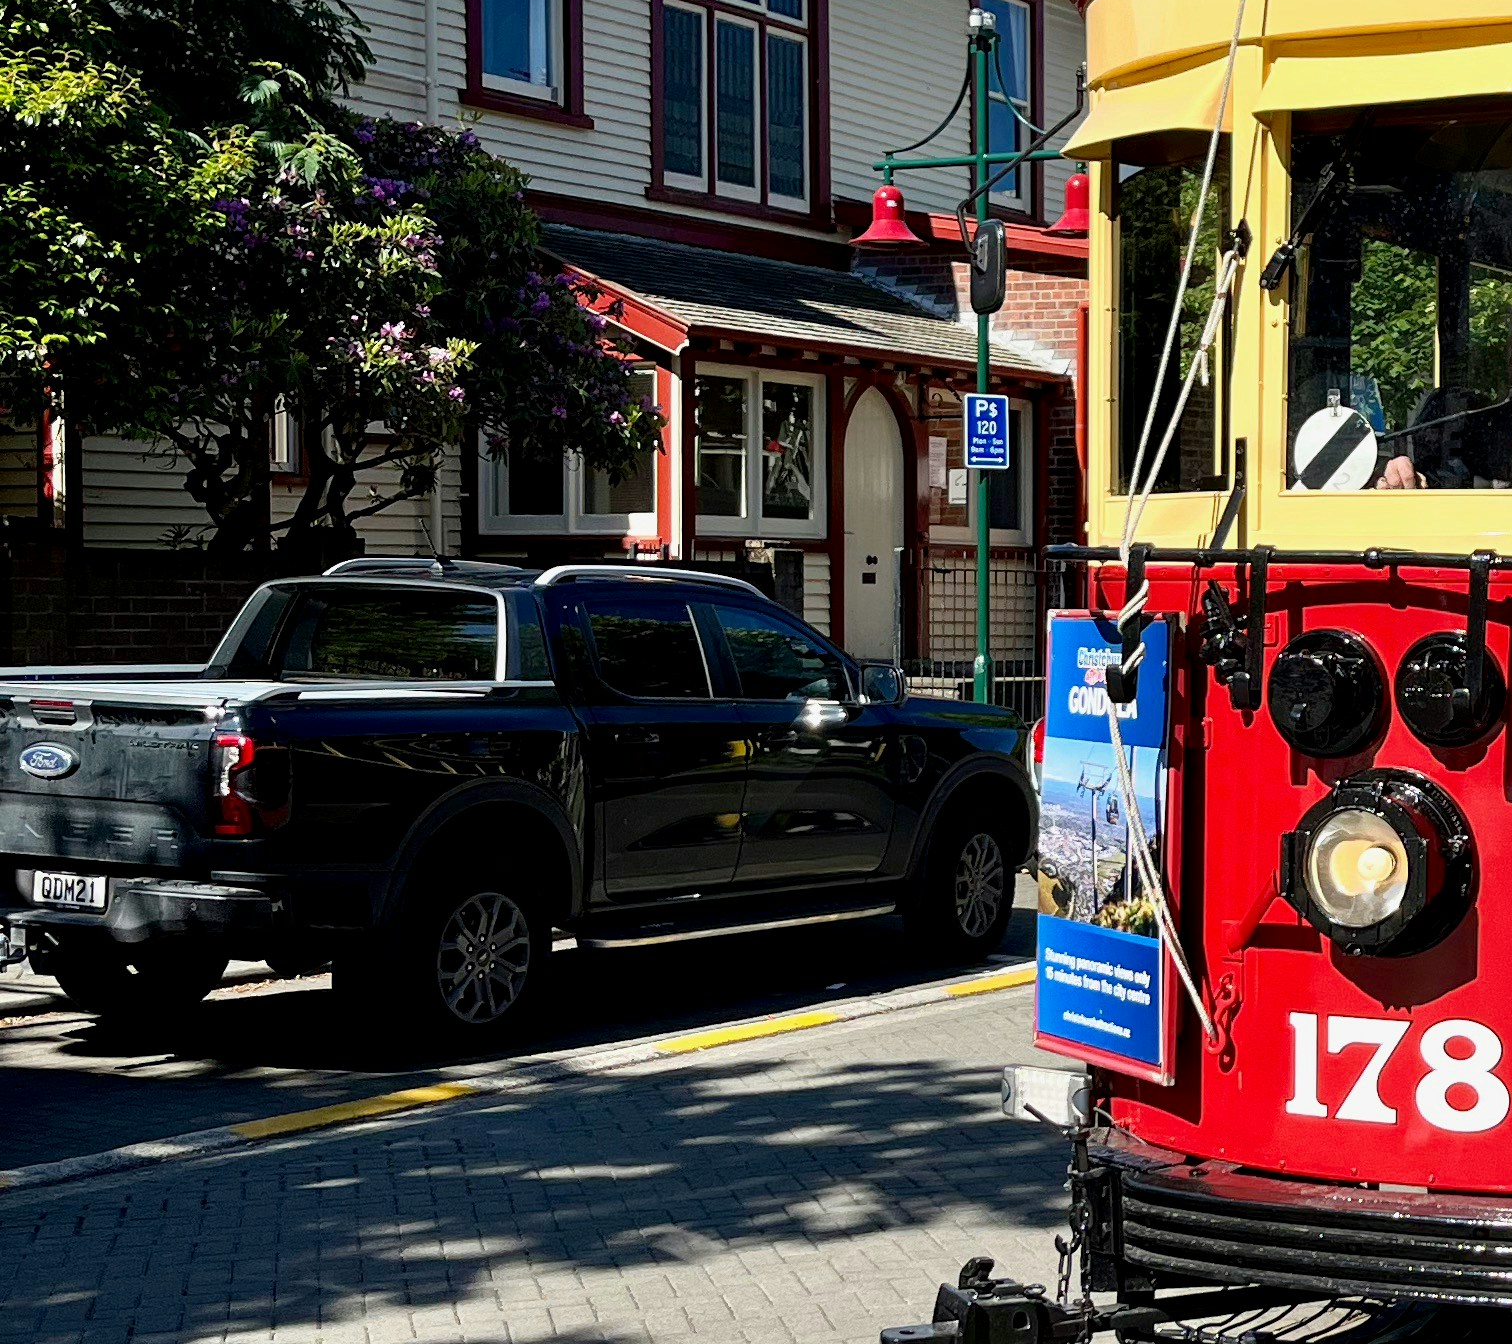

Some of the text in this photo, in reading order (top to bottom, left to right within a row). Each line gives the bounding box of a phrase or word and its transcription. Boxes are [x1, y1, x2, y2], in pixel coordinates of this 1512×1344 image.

[976, 420, 997, 435] 120
[992, 437, 1004, 445] Sun
[42, 876, 95, 904] QDM21
[1286, 1011, 1511, 1133] 178
